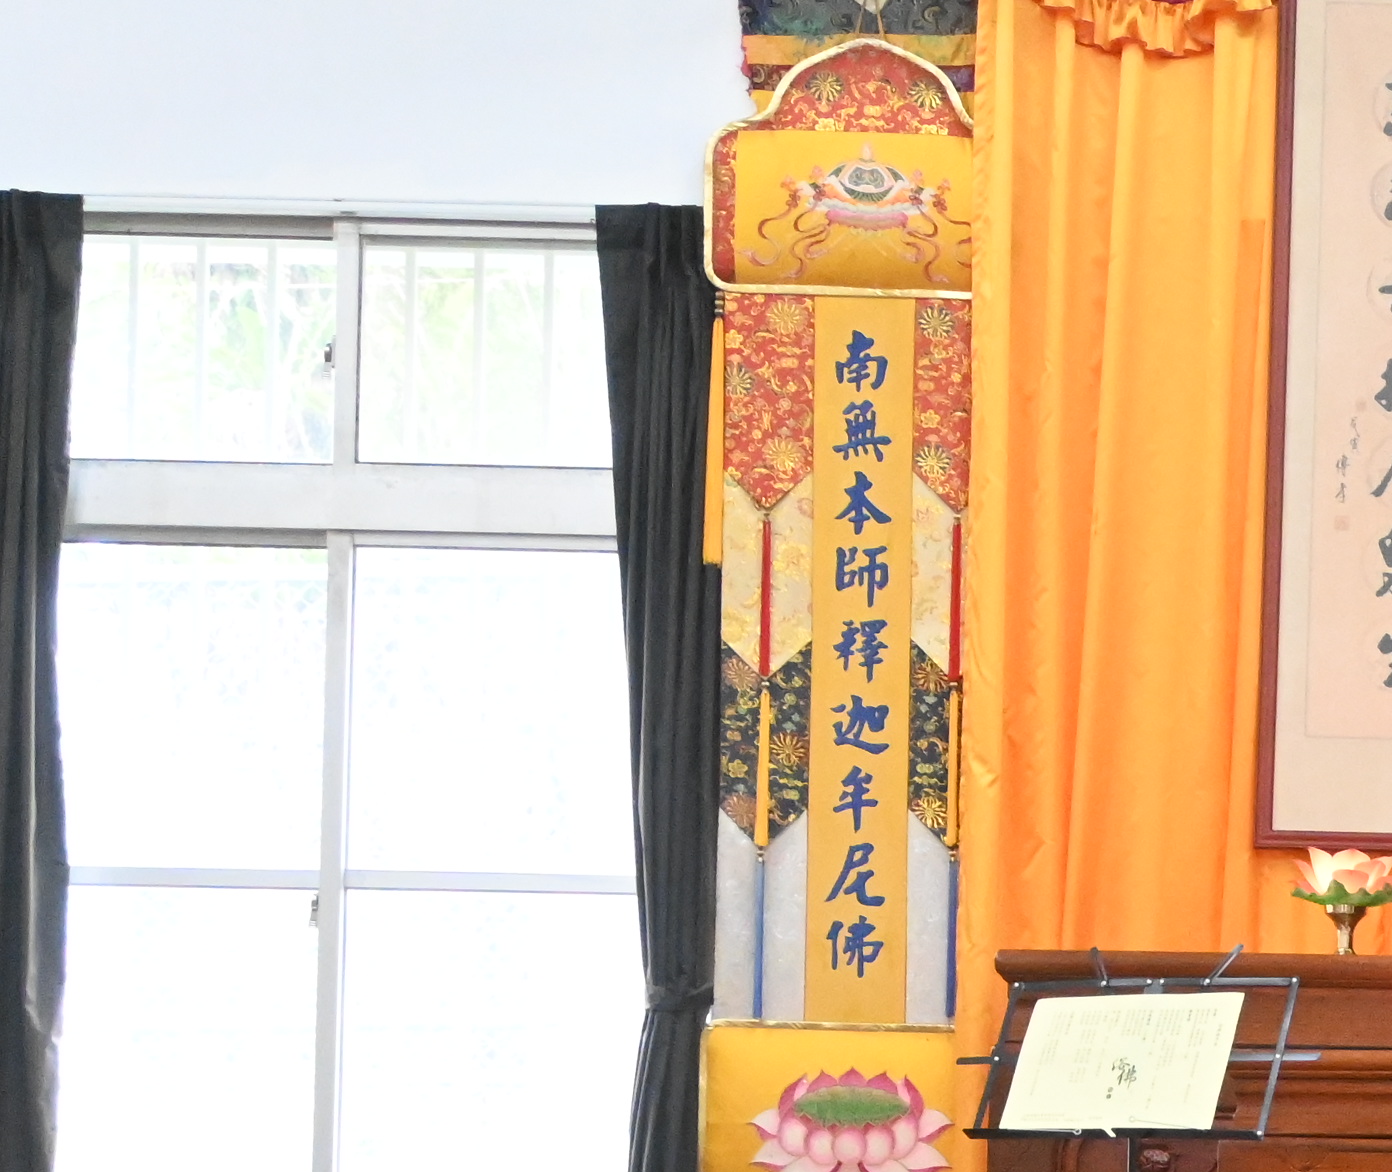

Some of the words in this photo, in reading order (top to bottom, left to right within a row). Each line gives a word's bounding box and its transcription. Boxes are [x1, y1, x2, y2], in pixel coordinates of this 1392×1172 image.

[825, 330, 892, 978] 南無本師釋迦牟尼佛
